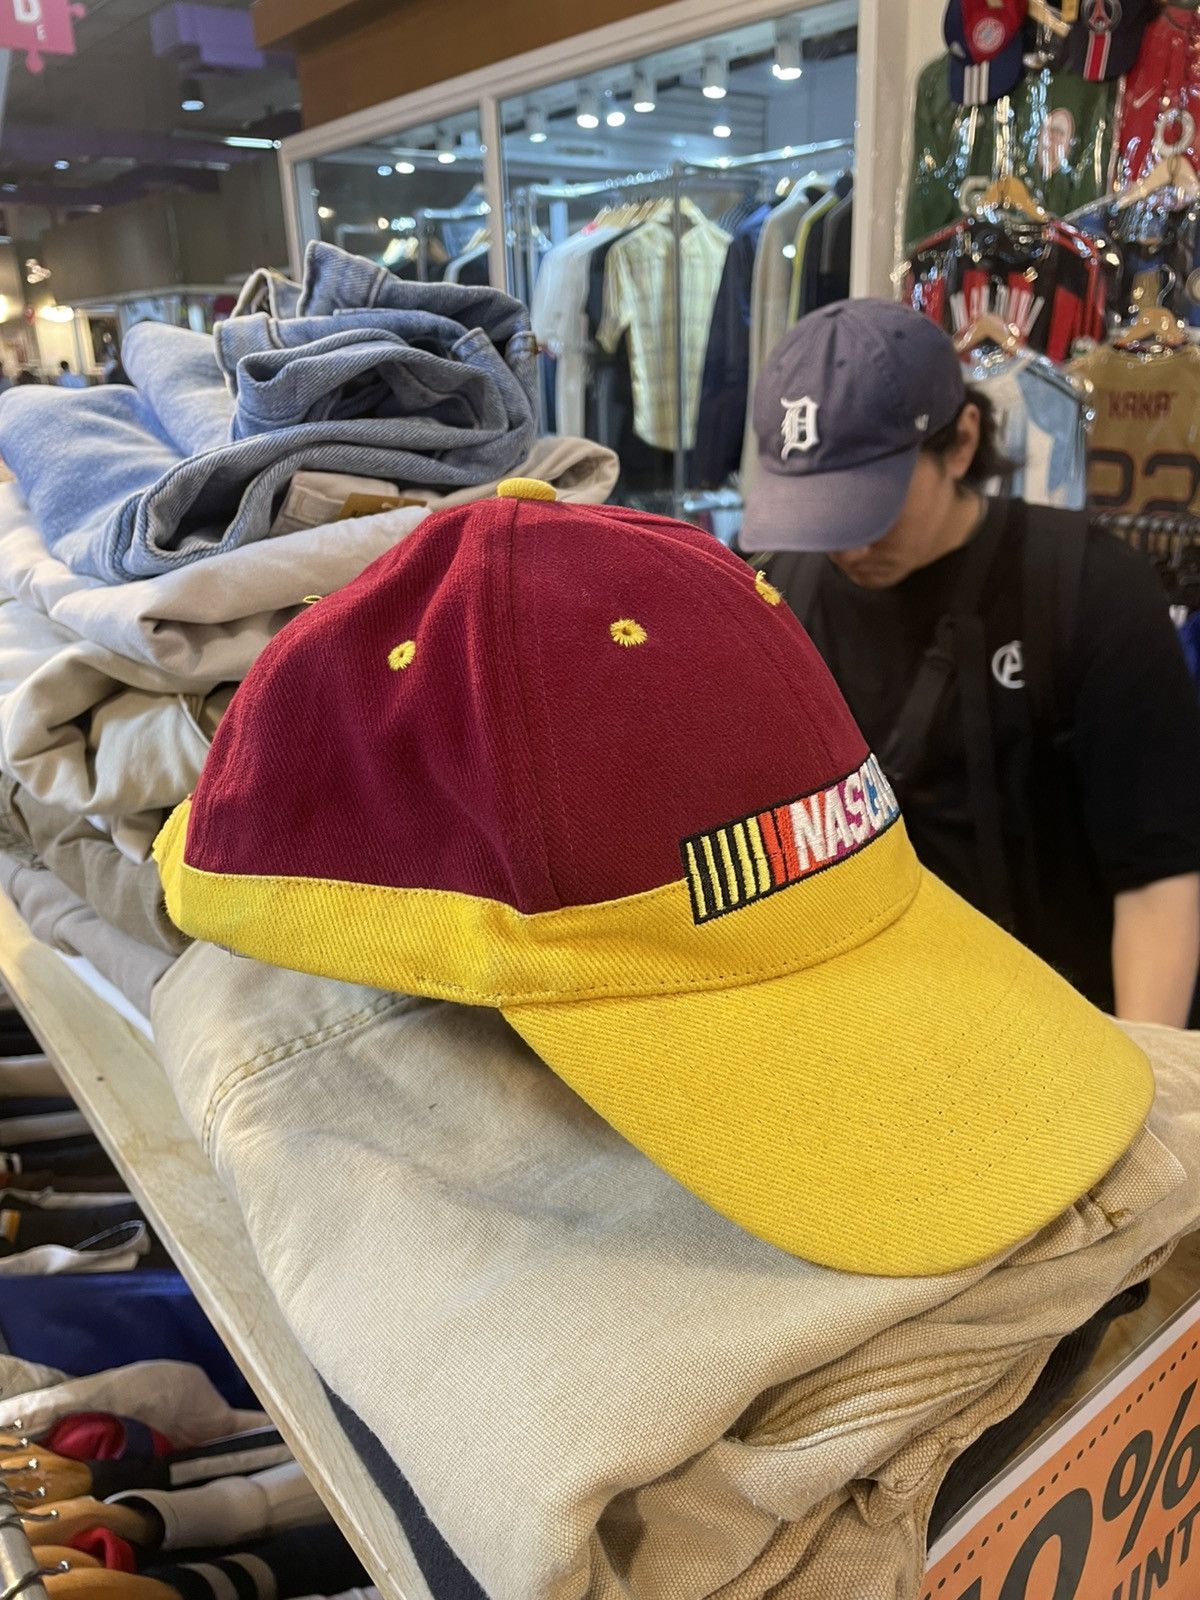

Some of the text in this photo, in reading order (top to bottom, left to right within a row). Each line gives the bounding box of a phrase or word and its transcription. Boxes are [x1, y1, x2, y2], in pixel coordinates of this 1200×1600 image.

[780, 396, 820, 461] D
[789, 752, 899, 872] NASCA
[956, 1379, 1200, 1600] 0%
